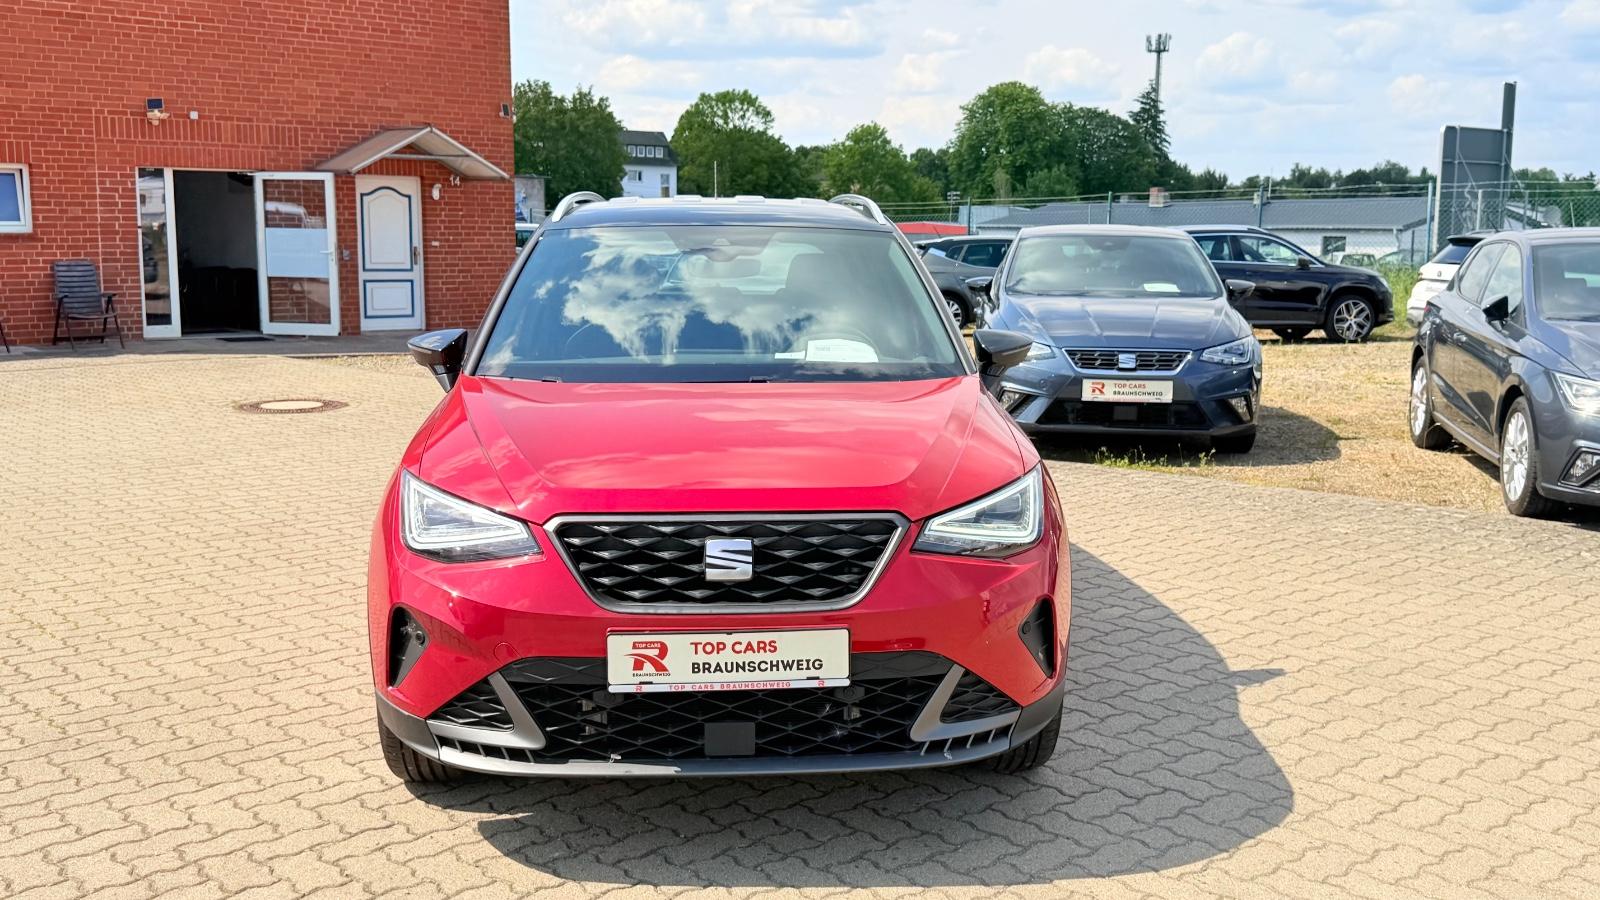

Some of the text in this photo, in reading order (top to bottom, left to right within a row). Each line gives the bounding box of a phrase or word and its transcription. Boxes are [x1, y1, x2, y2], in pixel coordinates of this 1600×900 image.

[450, 175, 460, 187] 14
[690, 640, 778, 655] TOP CARS
[691, 659, 824, 674] BRAUNSCHWEIG
[720, 681, 791, 690] BRAUNSCHWEIG
